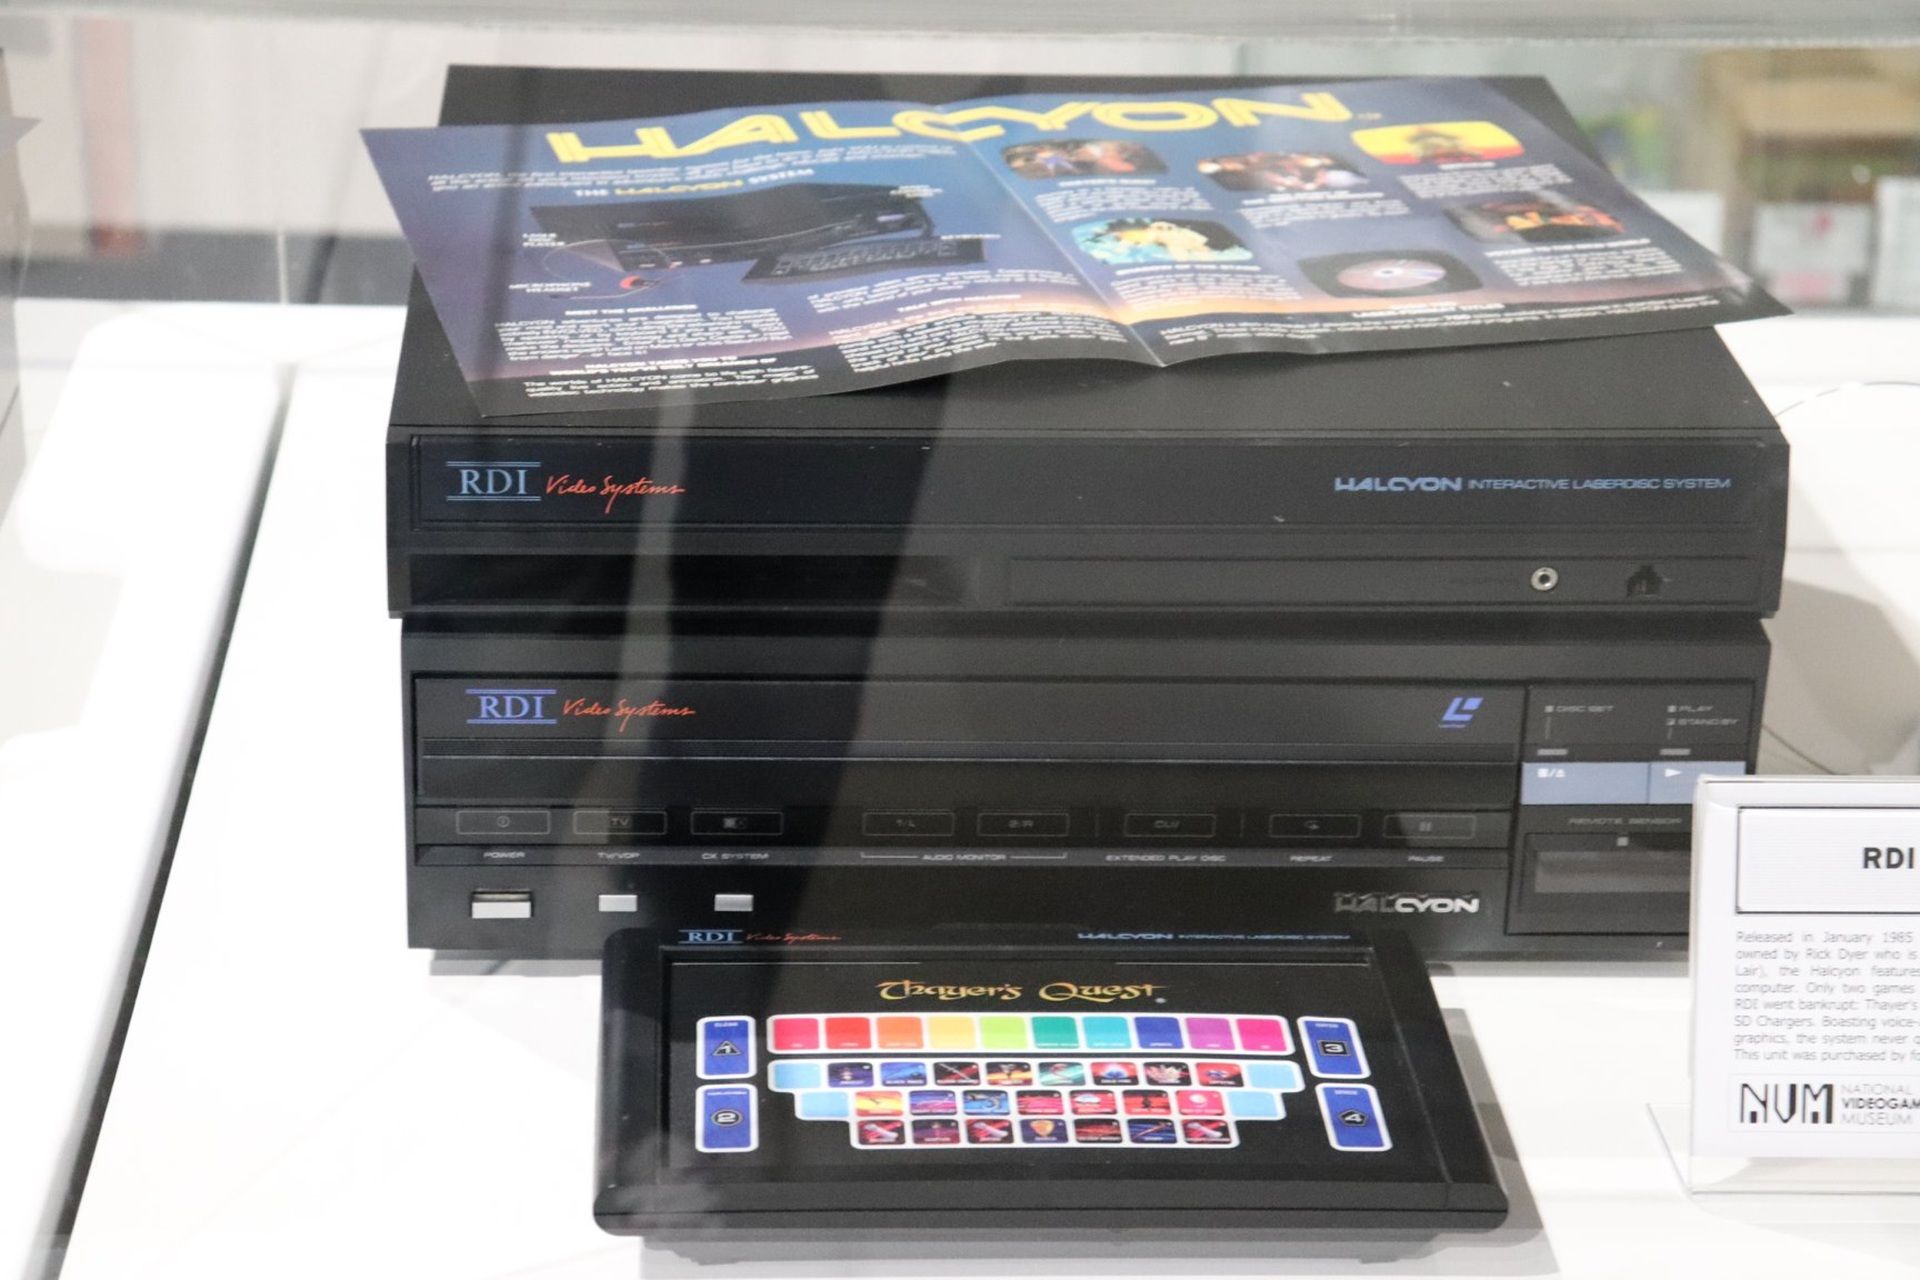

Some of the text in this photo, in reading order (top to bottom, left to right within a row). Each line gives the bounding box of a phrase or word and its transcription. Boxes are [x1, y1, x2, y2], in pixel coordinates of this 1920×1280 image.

[545, 91, 1354, 164] HALCYON
[1334, 476, 1732, 491] HALCYON INTERACTIVE LASERDISC SYSTEM
[459, 468, 686, 514] RDI Video Systems
[478, 695, 696, 733] RDI Video Systems
[483, 851, 526, 860] POWER
[721, 853, 770, 861] SYSTEM
[921, 853, 1007, 862] AUDIO MONITOR
[1104, 854, 1165, 863] EXTENDED
[1168, 854, 1198, 863] PLAY
[1862, 847, 1914, 870] RDI
[1334, 897, 1480, 913] HALCYON
[687, 931, 735, 942] RDI
[1077, 932, 1174, 940] HALCYON
[1735, 931, 1913, 945] Released in January 1985
[1735, 948, 1918, 962] owned by Rick Dyer who is
[1779, 965, 1800, 977] the
[1810, 965, 1861, 979] Halcyon
[875, 979, 1168, 1003] Thayer's Quest
[1806, 982, 1835, 995] Only
[1842, 983, 1866, 994] two
[1872, 983, 1915, 997] games
[1734, 998, 1760, 1010] RDI
[1763, 999, 1795, 1010] went
[1734, 1015, 1752, 1027] SD
[1821, 1015, 1876, 1029] Boasting
[1880, 1016, 1920, 1028] voice-
[1796, 1033, 1817, 1044] the
[1822, 1034, 1867, 1047] system
[1872, 1035, 1909, 1045] never
[1324, 1042, 1345, 1053] 3
[1734, 1049, 1760, 1061] This
[1763, 1050, 1788, 1061] unit
[1792, 1051, 1817, 1061] was
[1820, 1050, 1886, 1063] purchased
[1890, 1050, 1906, 1063] by
[1842, 1083, 1913, 1095] NATIONAL
[717, 1112, 737, 1123] 2
[1344, 1113, 1362, 1122] 4
[1842, 1112, 1912, 1124] MUSEUM
